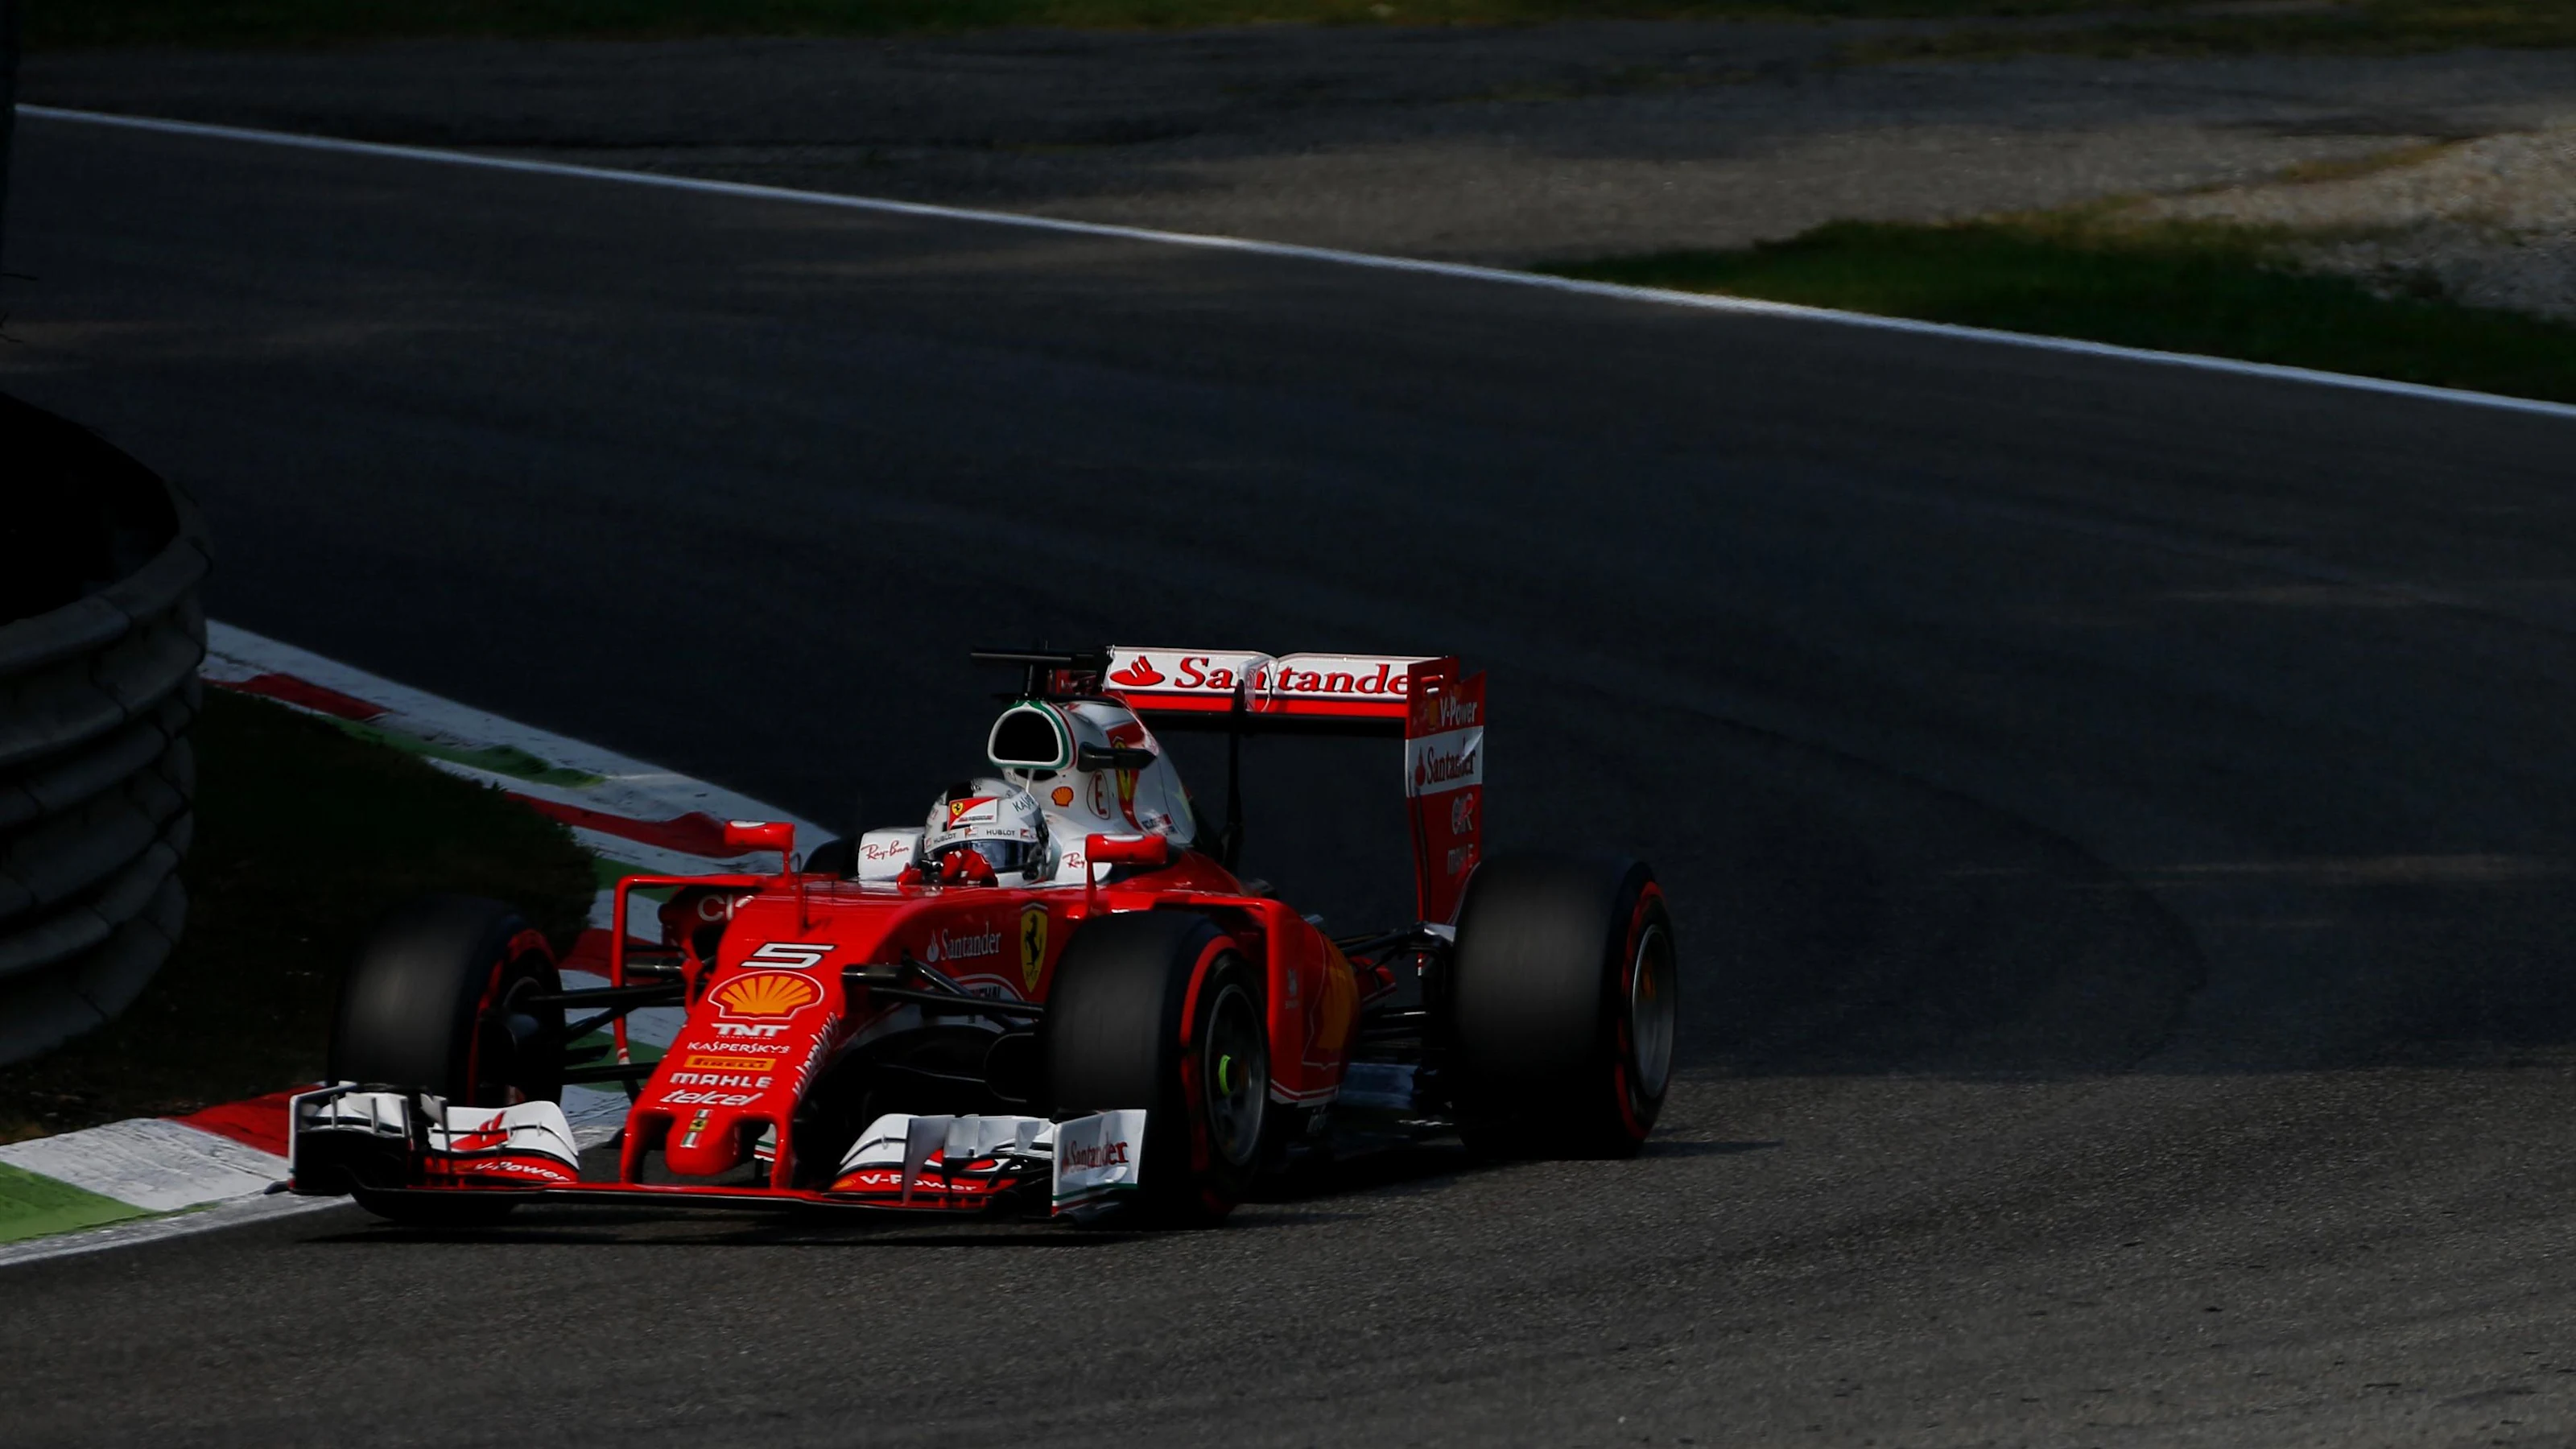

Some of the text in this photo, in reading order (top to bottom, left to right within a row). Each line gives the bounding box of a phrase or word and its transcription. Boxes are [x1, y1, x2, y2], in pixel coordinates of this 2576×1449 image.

[1174, 656, 1409, 695] Santande
[1439, 696, 1477, 726] V-Power
[934, 833, 956, 843] HUBLOT
[861, 840, 909, 860] Ray-Ban
[1062, 852, 1086, 868] Ray
[940, 920, 1001, 961] Santander
[740, 942, 837, 969] 5
[710, 1022, 791, 1037] TNT
[669, 1072, 775, 1088] MAHLE
[659, 1089, 764, 1106] telcel
[1071, 1125, 1129, 1173] Santander
[474, 1161, 570, 1182] V-Power
[859, 1173, 977, 1192] V-Power
